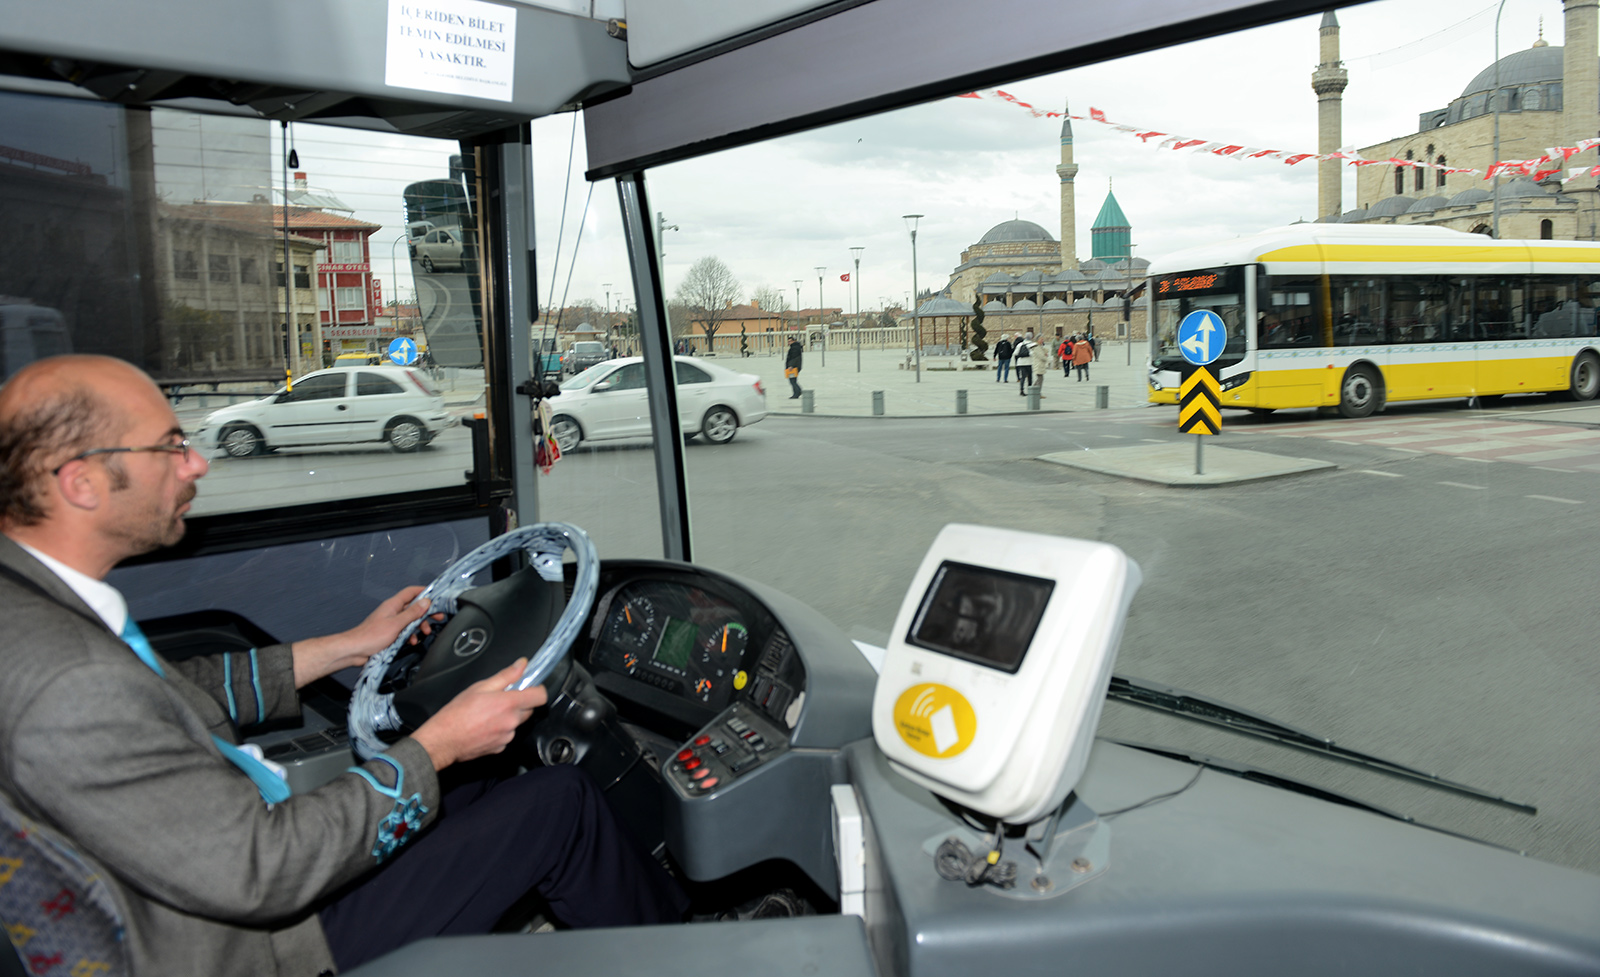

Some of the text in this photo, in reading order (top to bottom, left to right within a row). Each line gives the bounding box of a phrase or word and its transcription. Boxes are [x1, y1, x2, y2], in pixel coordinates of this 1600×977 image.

[468, 16, 505, 33] BİLET
[445, 32, 506, 53] EDİLMESİ
[373, 280, 382, 316] OTEL
